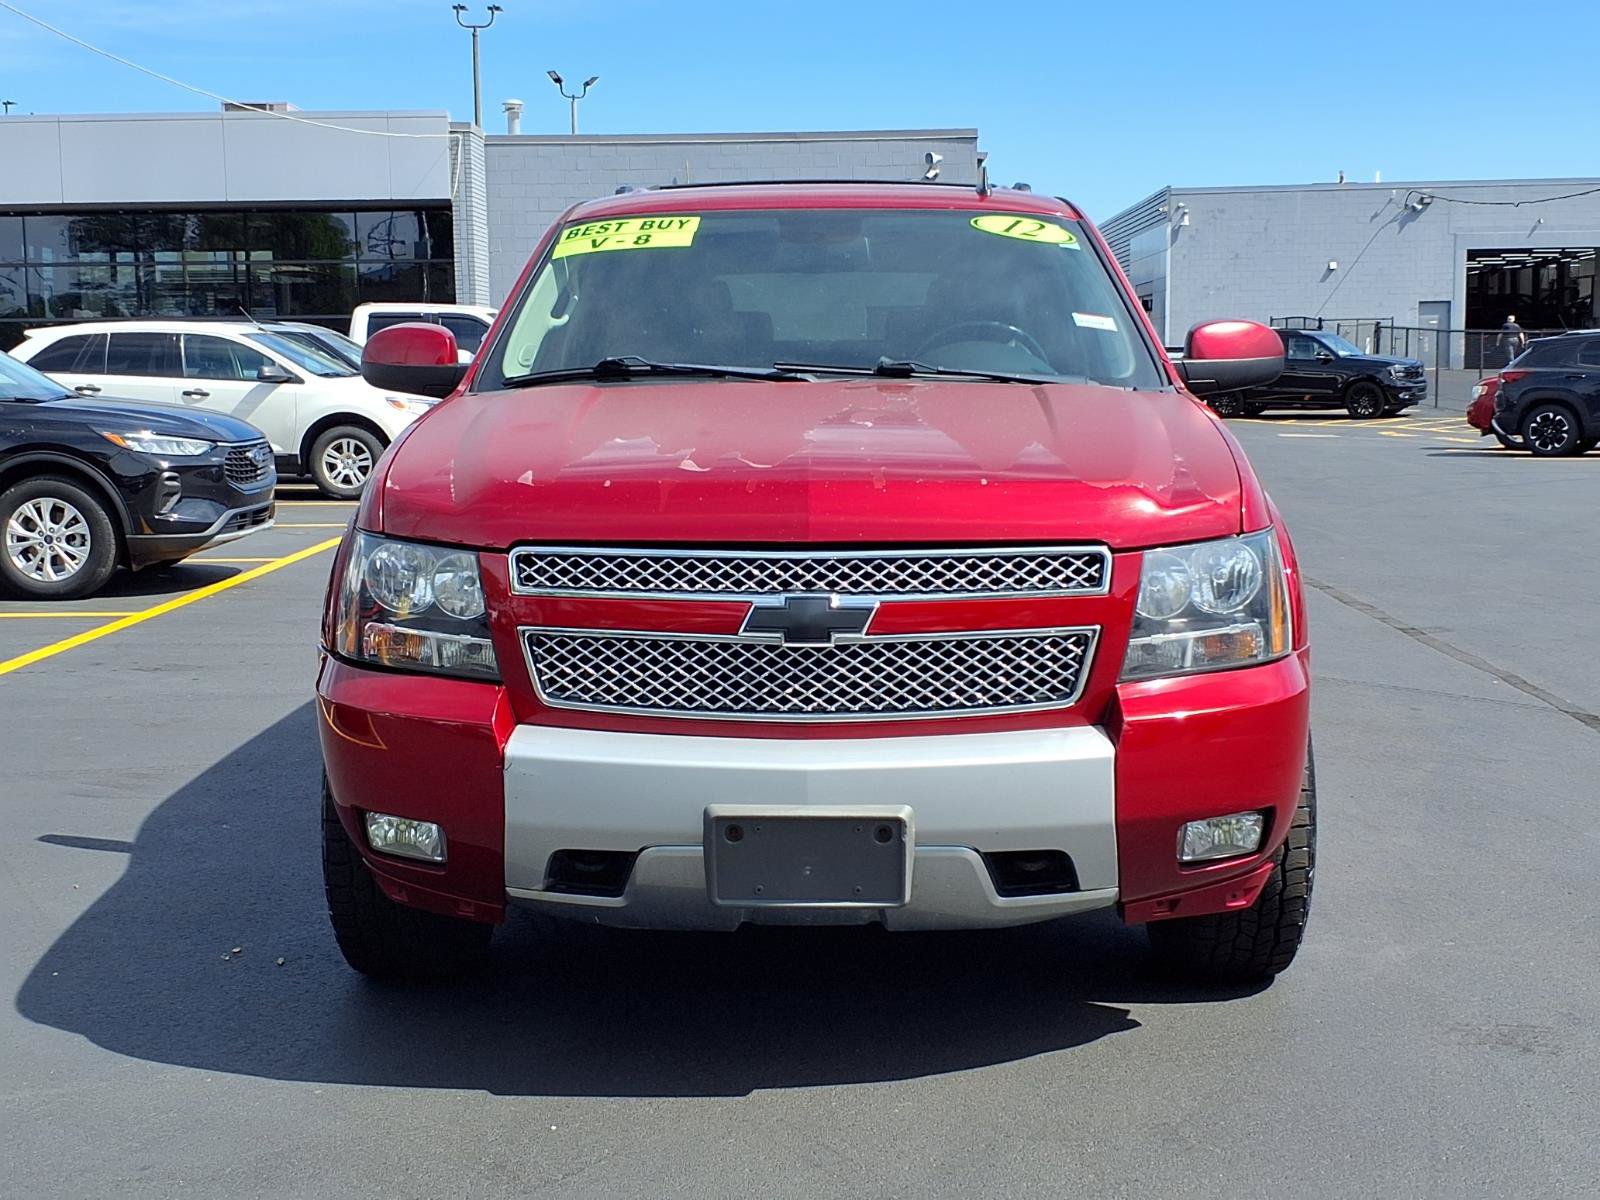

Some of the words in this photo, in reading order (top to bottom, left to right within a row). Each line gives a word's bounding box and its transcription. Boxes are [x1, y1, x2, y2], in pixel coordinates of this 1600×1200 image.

[566, 222, 629, 240] BEST
[639, 219, 690, 231] BUY
[1003, 220, 1045, 237] 12
